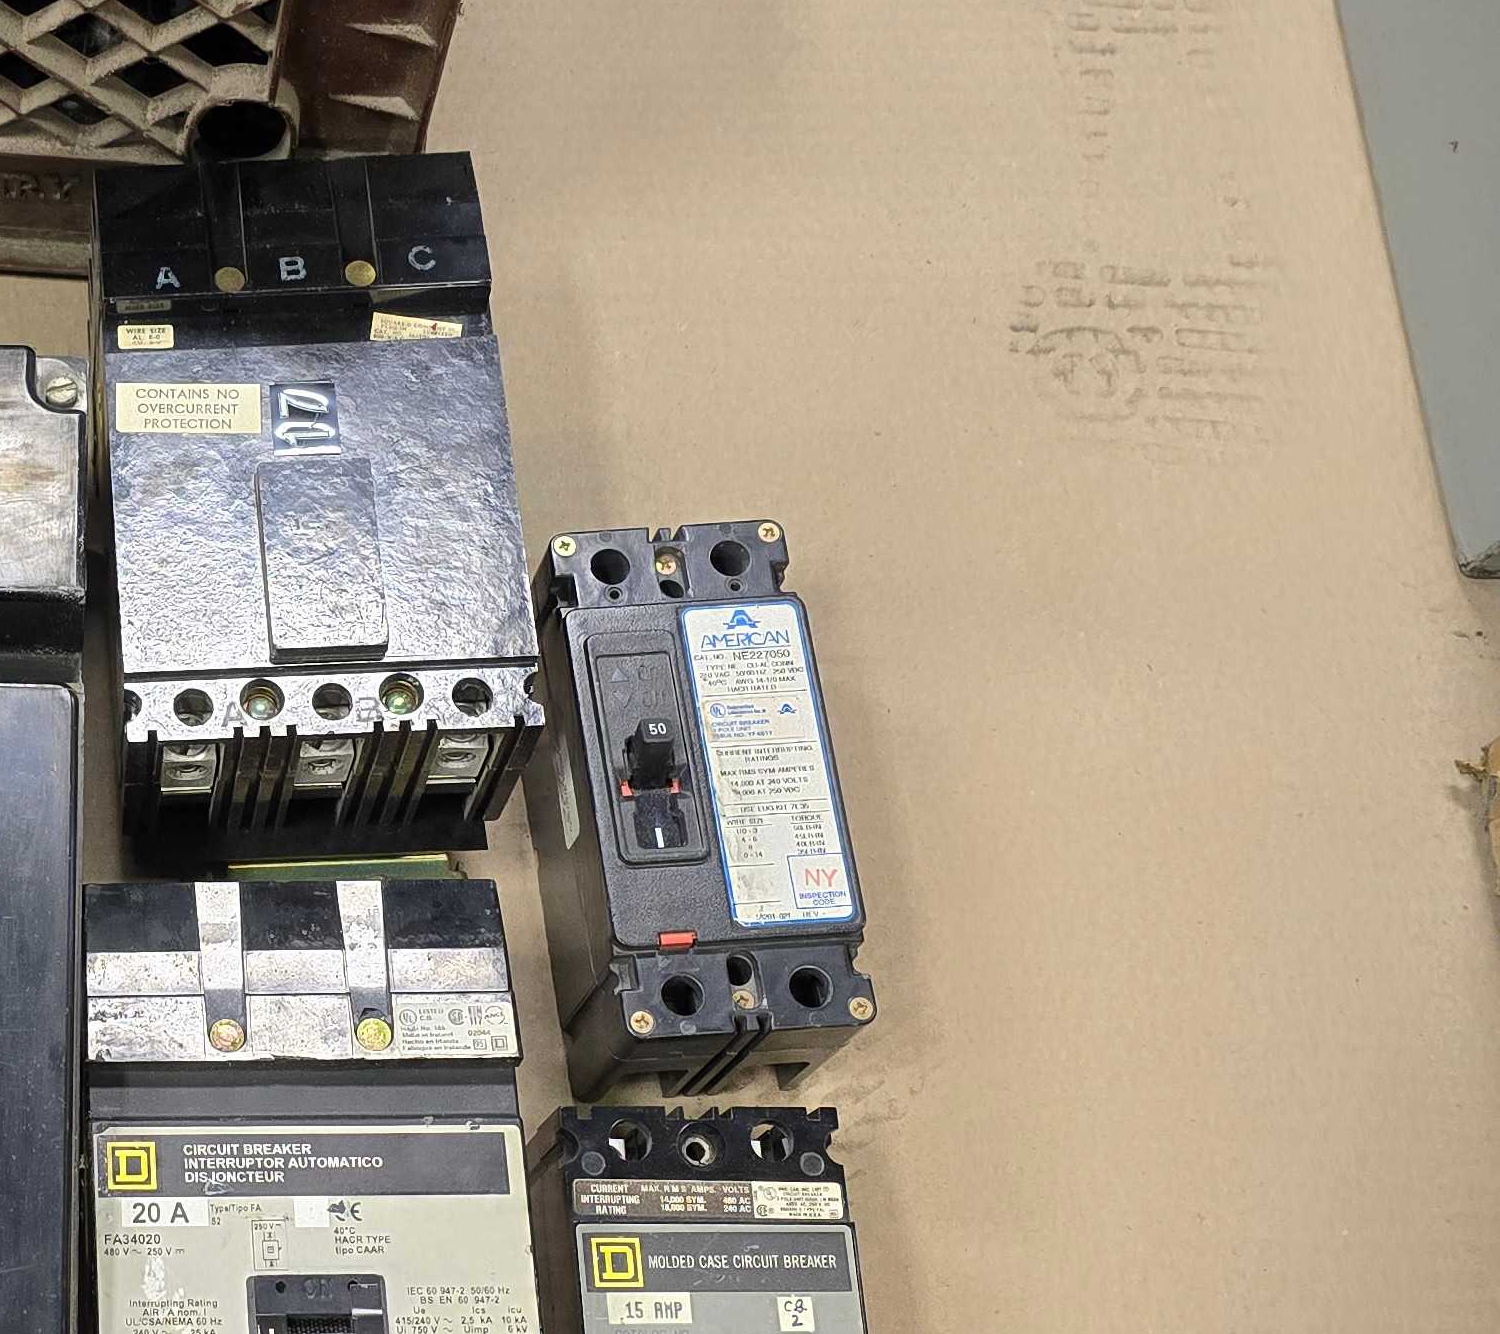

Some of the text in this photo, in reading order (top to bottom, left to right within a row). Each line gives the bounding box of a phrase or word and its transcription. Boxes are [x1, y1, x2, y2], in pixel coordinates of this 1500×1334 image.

[156, 246, 437, 290] A B C
[136, 388, 240, 400] CONTAINS NO
[138, 403, 239, 415] OVERCURRENT
[144, 418, 232, 429] PROTECTION
[701, 629, 790, 648] AMERICAN
[732, 649, 791, 661] NE227050
[649, 723, 667, 735] 50
[804, 868, 838, 887] NY
[799, 891, 846, 899] INSPECTION
[183, 1143, 312, 1155] CIRCUIT BREAKER
[184, 1156, 383, 1169] INTERRUPTOR AUTOMATICO
[184, 1171, 285, 1183] DISJONCTEUR
[590, 1184, 629, 1194] CURRENT
[722, 1185, 749, 1194] VOLTS
[581, 1195, 751, 1205] INTERRUPTING 14,000 AC
[132, 1202, 190, 1223] 20 A
[210, 1203, 262, 1214] Type/Tipo FA
[596, 1205, 627, 1215] RATING
[104, 1234, 161, 1245] FA34020
[334, 1235, 391, 1244] HACR TYPE
[104, 1247, 165, 1256] 480 250
[356, 1245, 385, 1254] CAAR
[648, 1255, 836, 1269] MOLDED CASE CIRCUIT BREAKER
[407, 1286, 511, 1296] IEC 60 947-2 50/60 Hz
[129, 1299, 218, 1309] Interrupting Rating
[420, 1295, 500, 1305] BS EN 60 947-2
[413, 1306, 426, 1315] Ue
[625, 1302, 683, 1319] 15 AMP
[196, 1318, 207, 1326] 60
[210, 1318, 223, 1326] Hz
[395, 1315, 528, 1325] 415/240 kA 10 kA
[791, 1315, 803, 1327] 2
[412, 1324, 528, 1334] 750 Uimp kV
